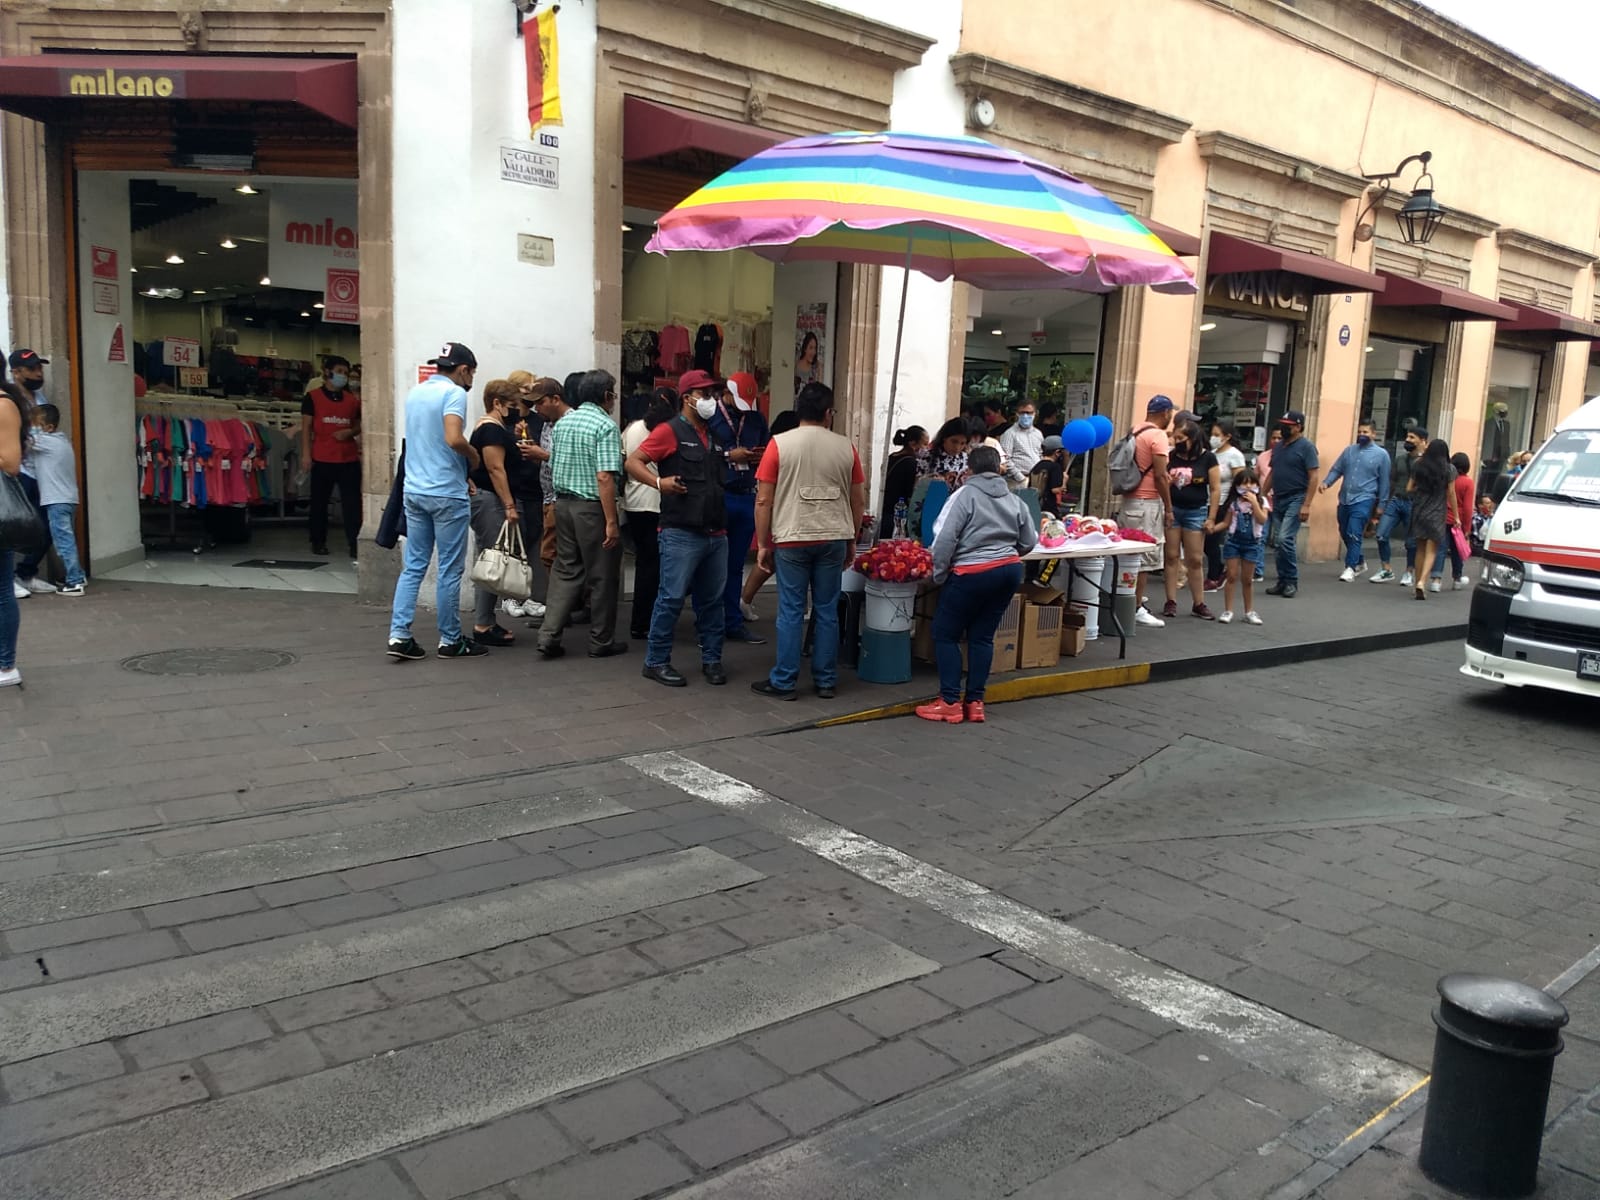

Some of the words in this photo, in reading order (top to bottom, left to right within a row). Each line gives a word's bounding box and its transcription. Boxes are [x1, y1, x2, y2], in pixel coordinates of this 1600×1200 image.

[70, 68, 173, 97] milano
[541, 134, 558, 147] 100
[503, 158, 555, 179] VALLADOLID
[286, 217, 358, 249] mila
[1504, 518, 1523, 535] 59
